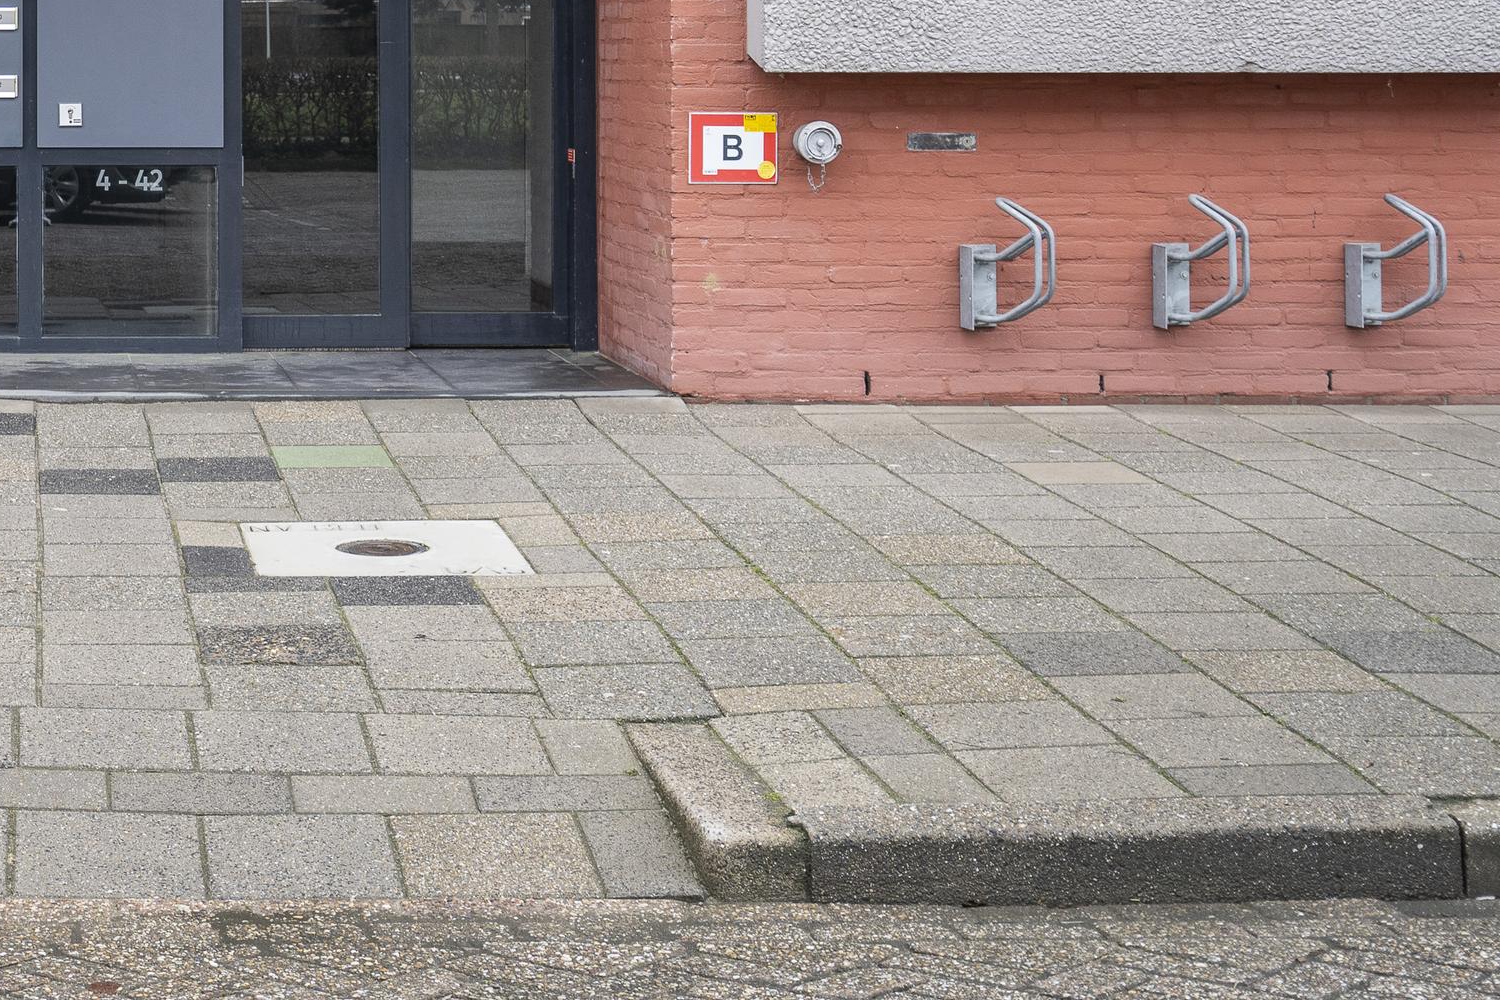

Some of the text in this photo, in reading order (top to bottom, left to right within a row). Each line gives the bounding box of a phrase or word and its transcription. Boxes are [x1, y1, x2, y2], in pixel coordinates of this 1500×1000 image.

[723, 134, 743, 161] B
[96, 169, 111, 191] 4
[134, 169, 163, 191] 42
